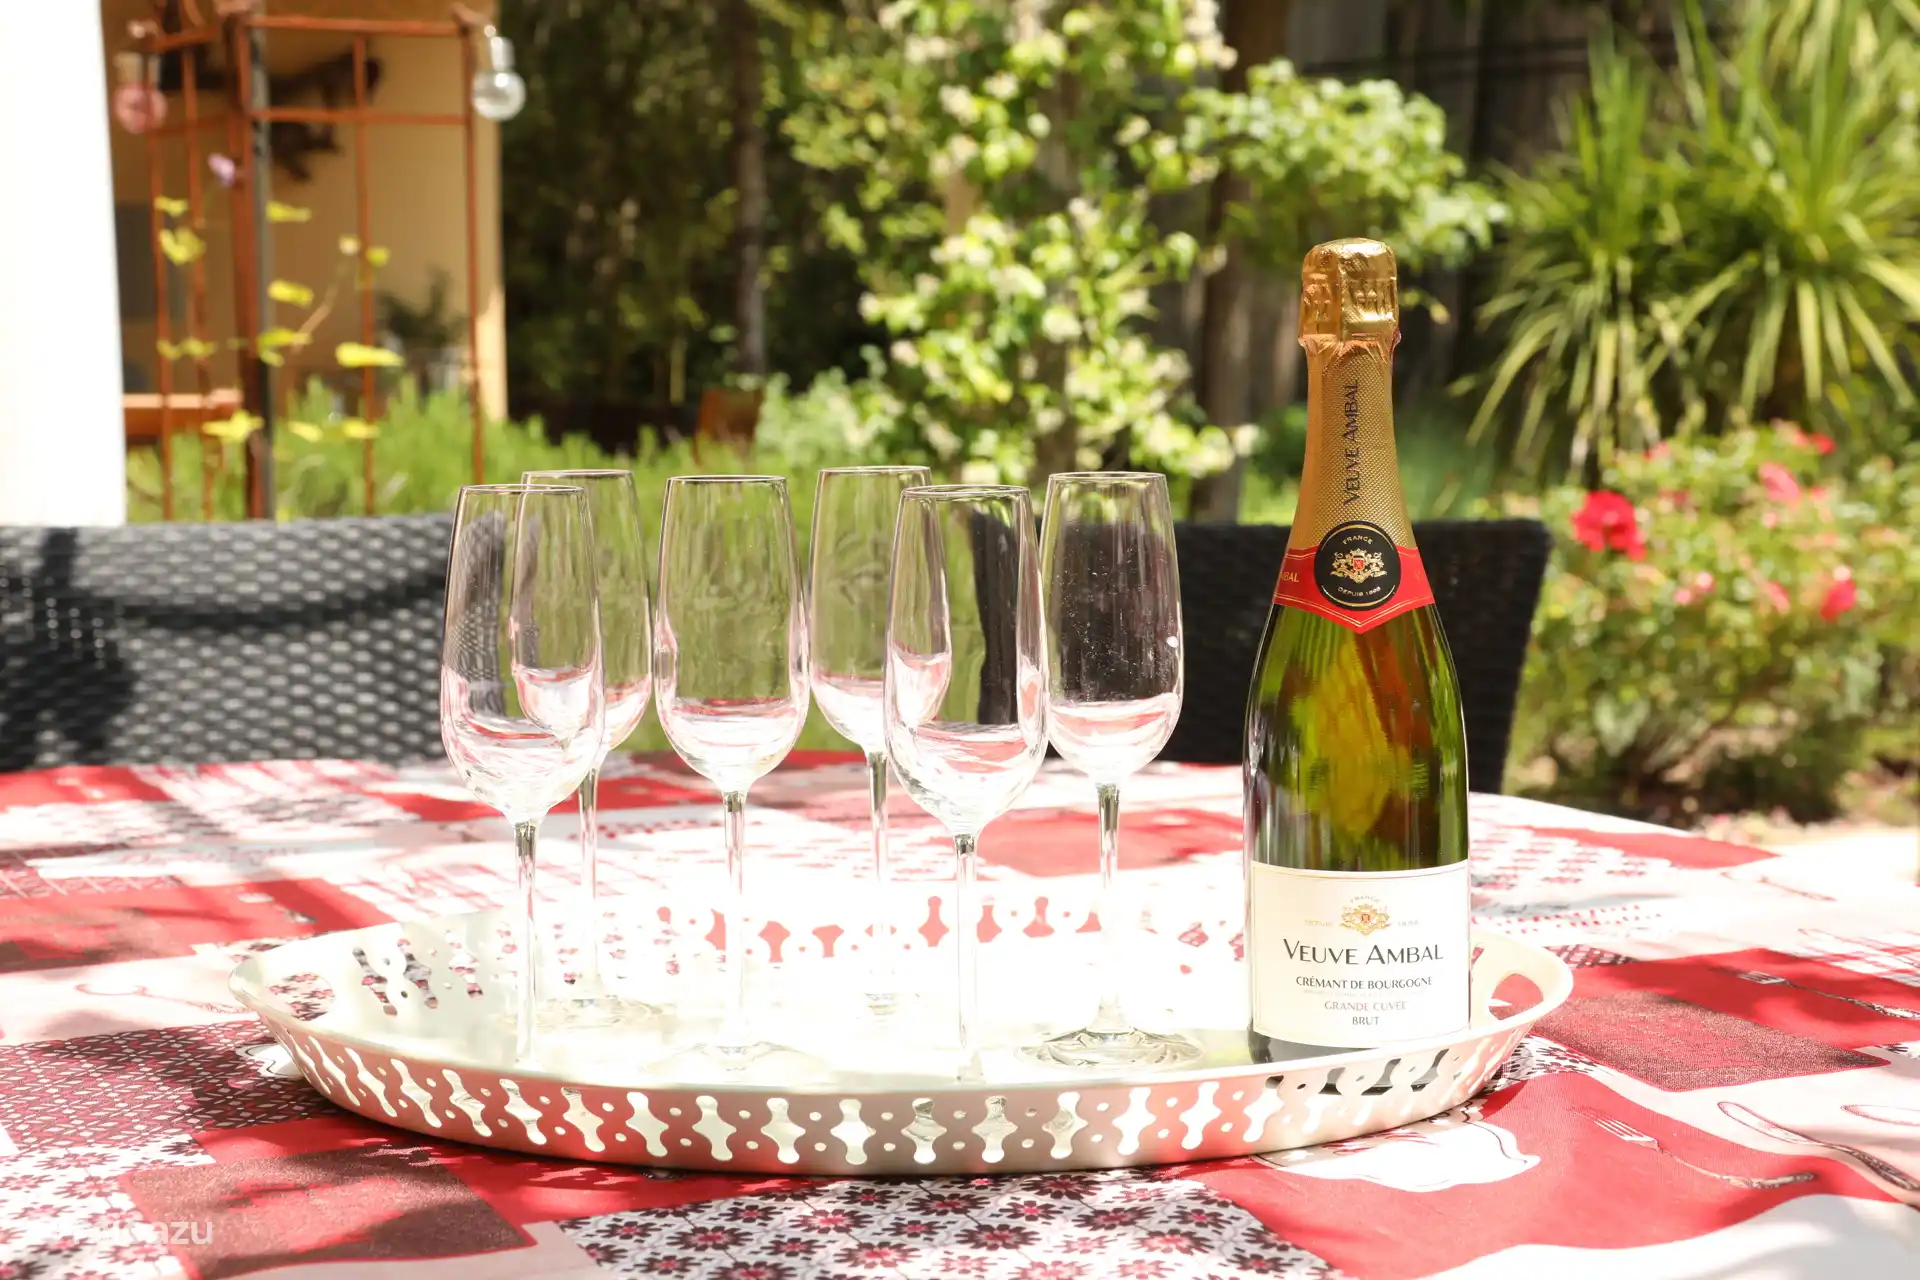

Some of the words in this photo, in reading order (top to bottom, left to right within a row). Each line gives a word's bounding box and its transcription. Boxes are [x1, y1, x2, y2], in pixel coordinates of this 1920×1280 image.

[1343, 379, 1359, 442] AMBAL
[1343, 444, 1361, 505] VEUVE
[1342, 534, 1374, 545] FRANCE
[1282, 938, 1360, 965] VEUVE
[1365, 943, 1444, 965] AMBAL
[1295, 975, 1349, 989] CRÉMANT
[1350, 980, 1365, 990] DE
[1367, 976, 1433, 990] BOURGOGNE
[1324, 1000, 1369, 1012] GRANDE
[1352, 1016, 1380, 1026] BRUT
